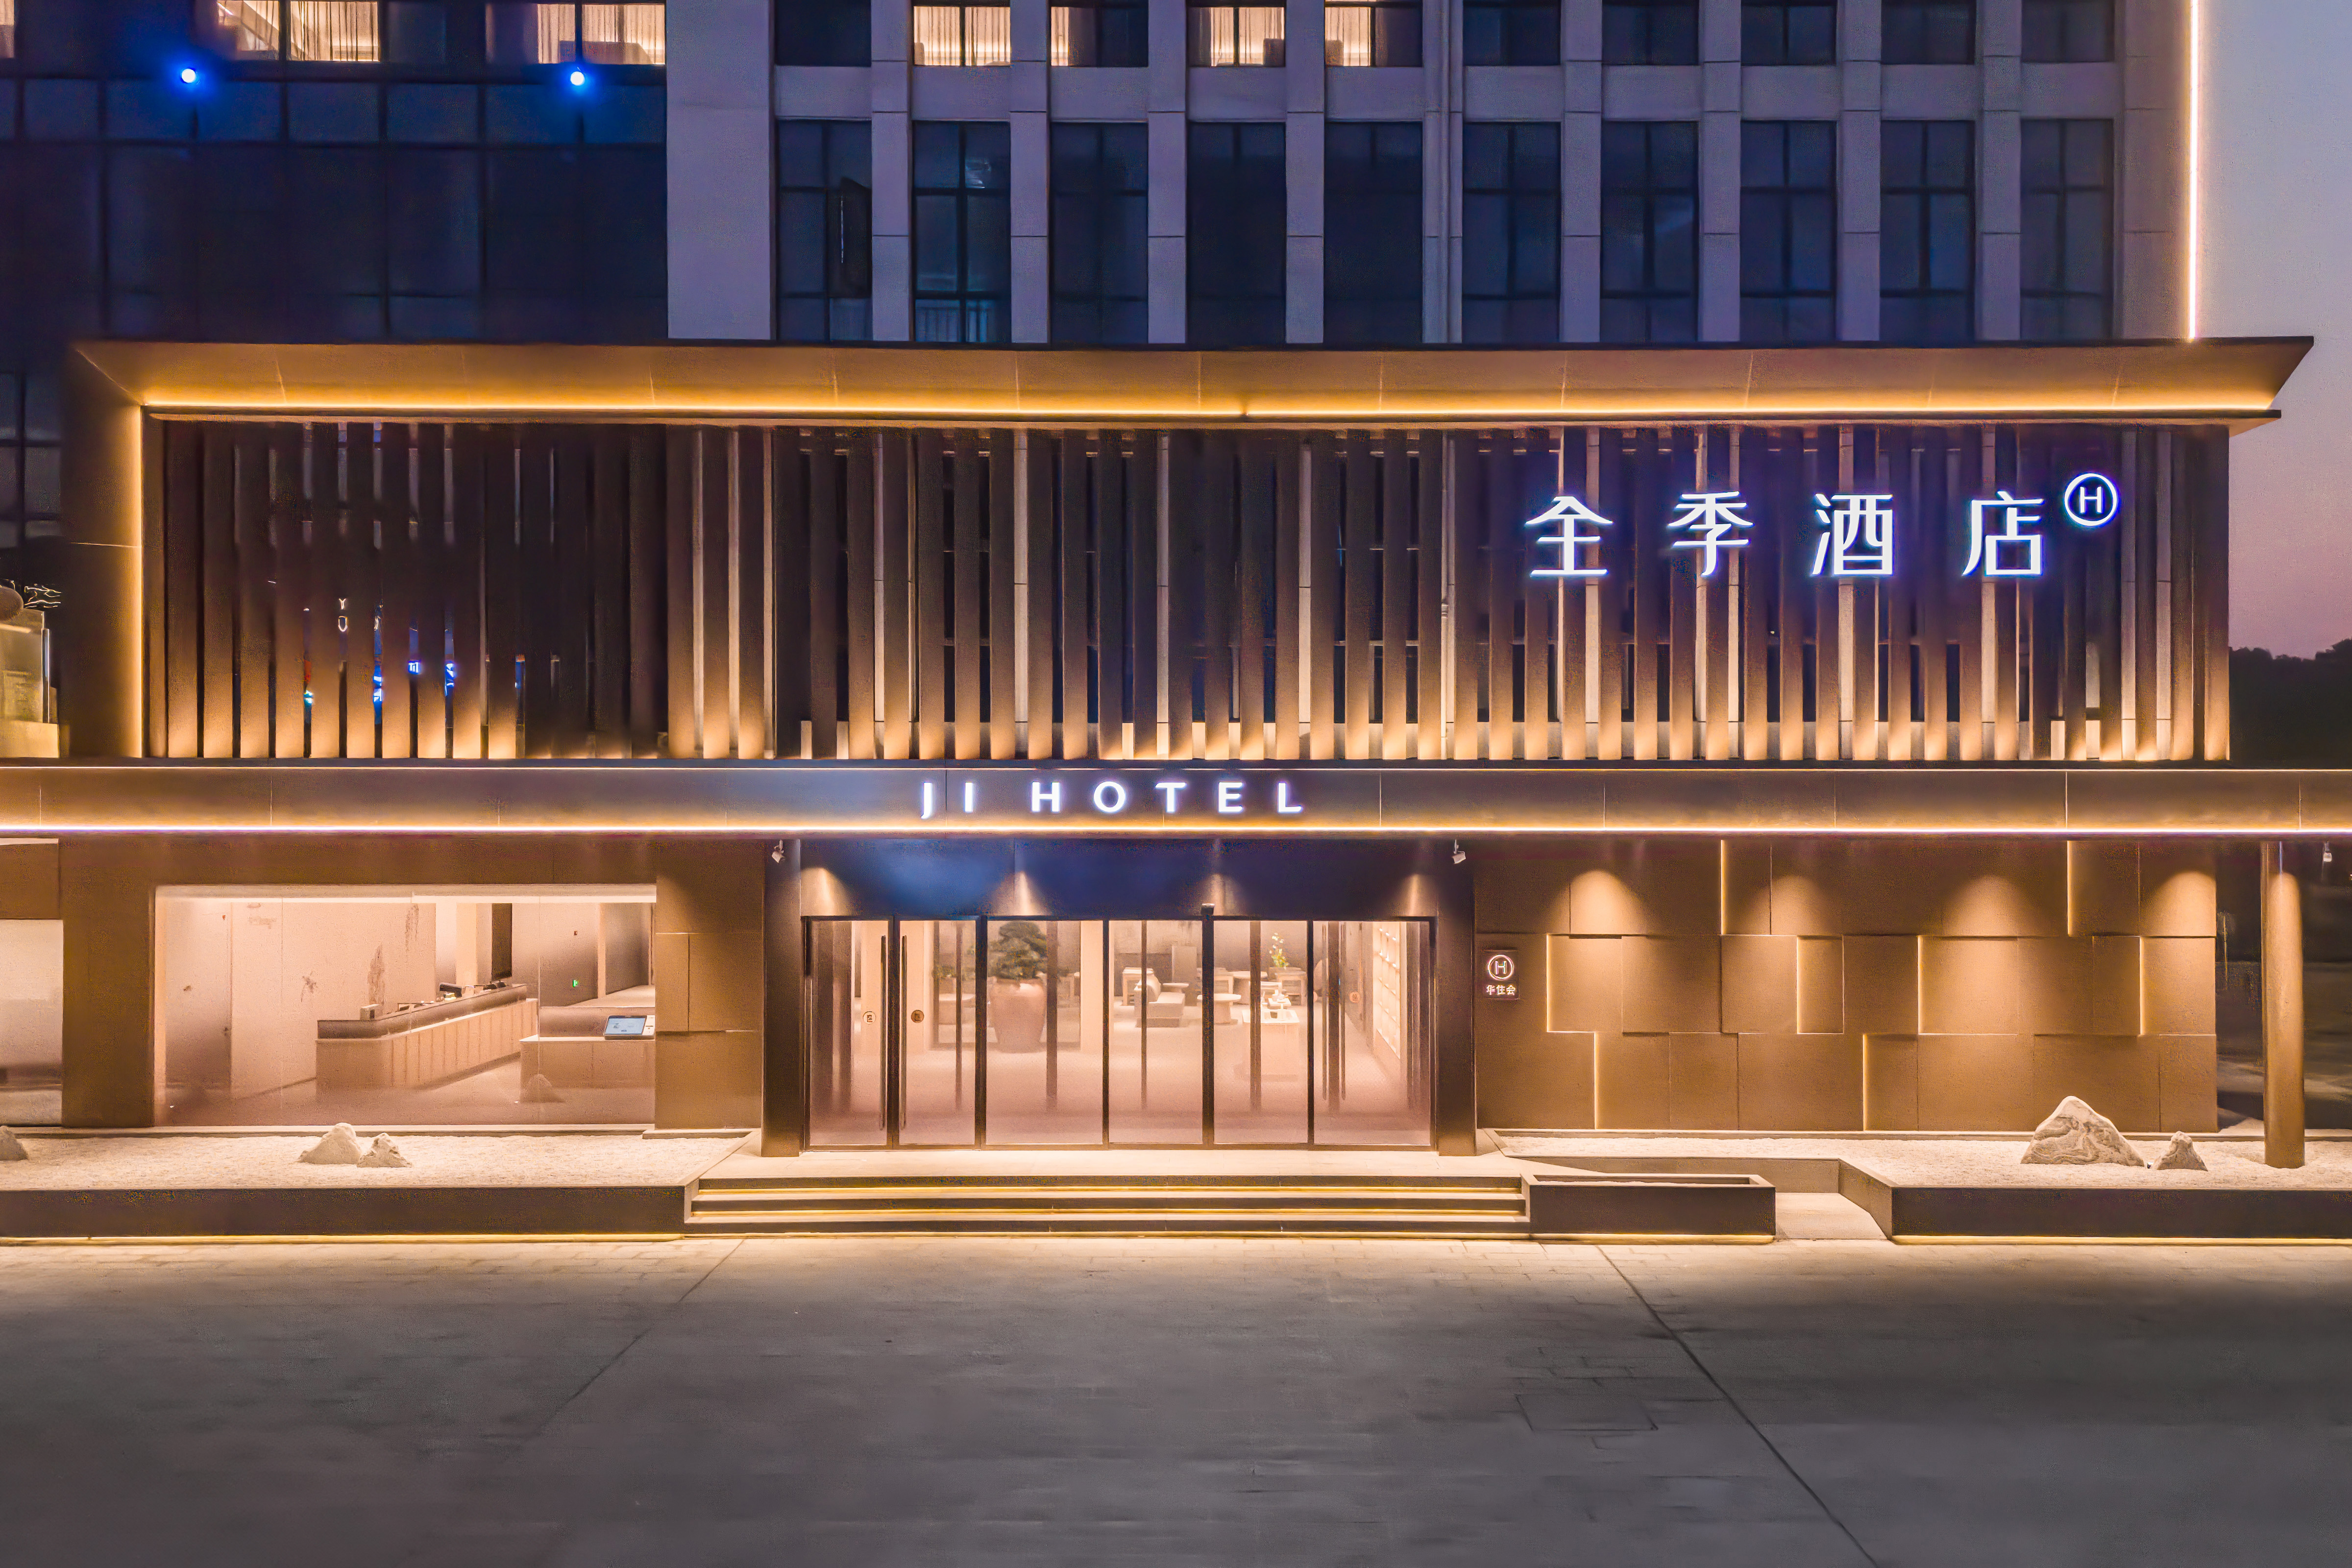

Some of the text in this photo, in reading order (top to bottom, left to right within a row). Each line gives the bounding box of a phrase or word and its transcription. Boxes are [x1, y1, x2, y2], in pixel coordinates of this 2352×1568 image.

[1525, 490, 2044, 577] 全季酒店
[920, 781, 1303, 820] JI HOTEL
[1486, 984, 1516, 996] 华住会
